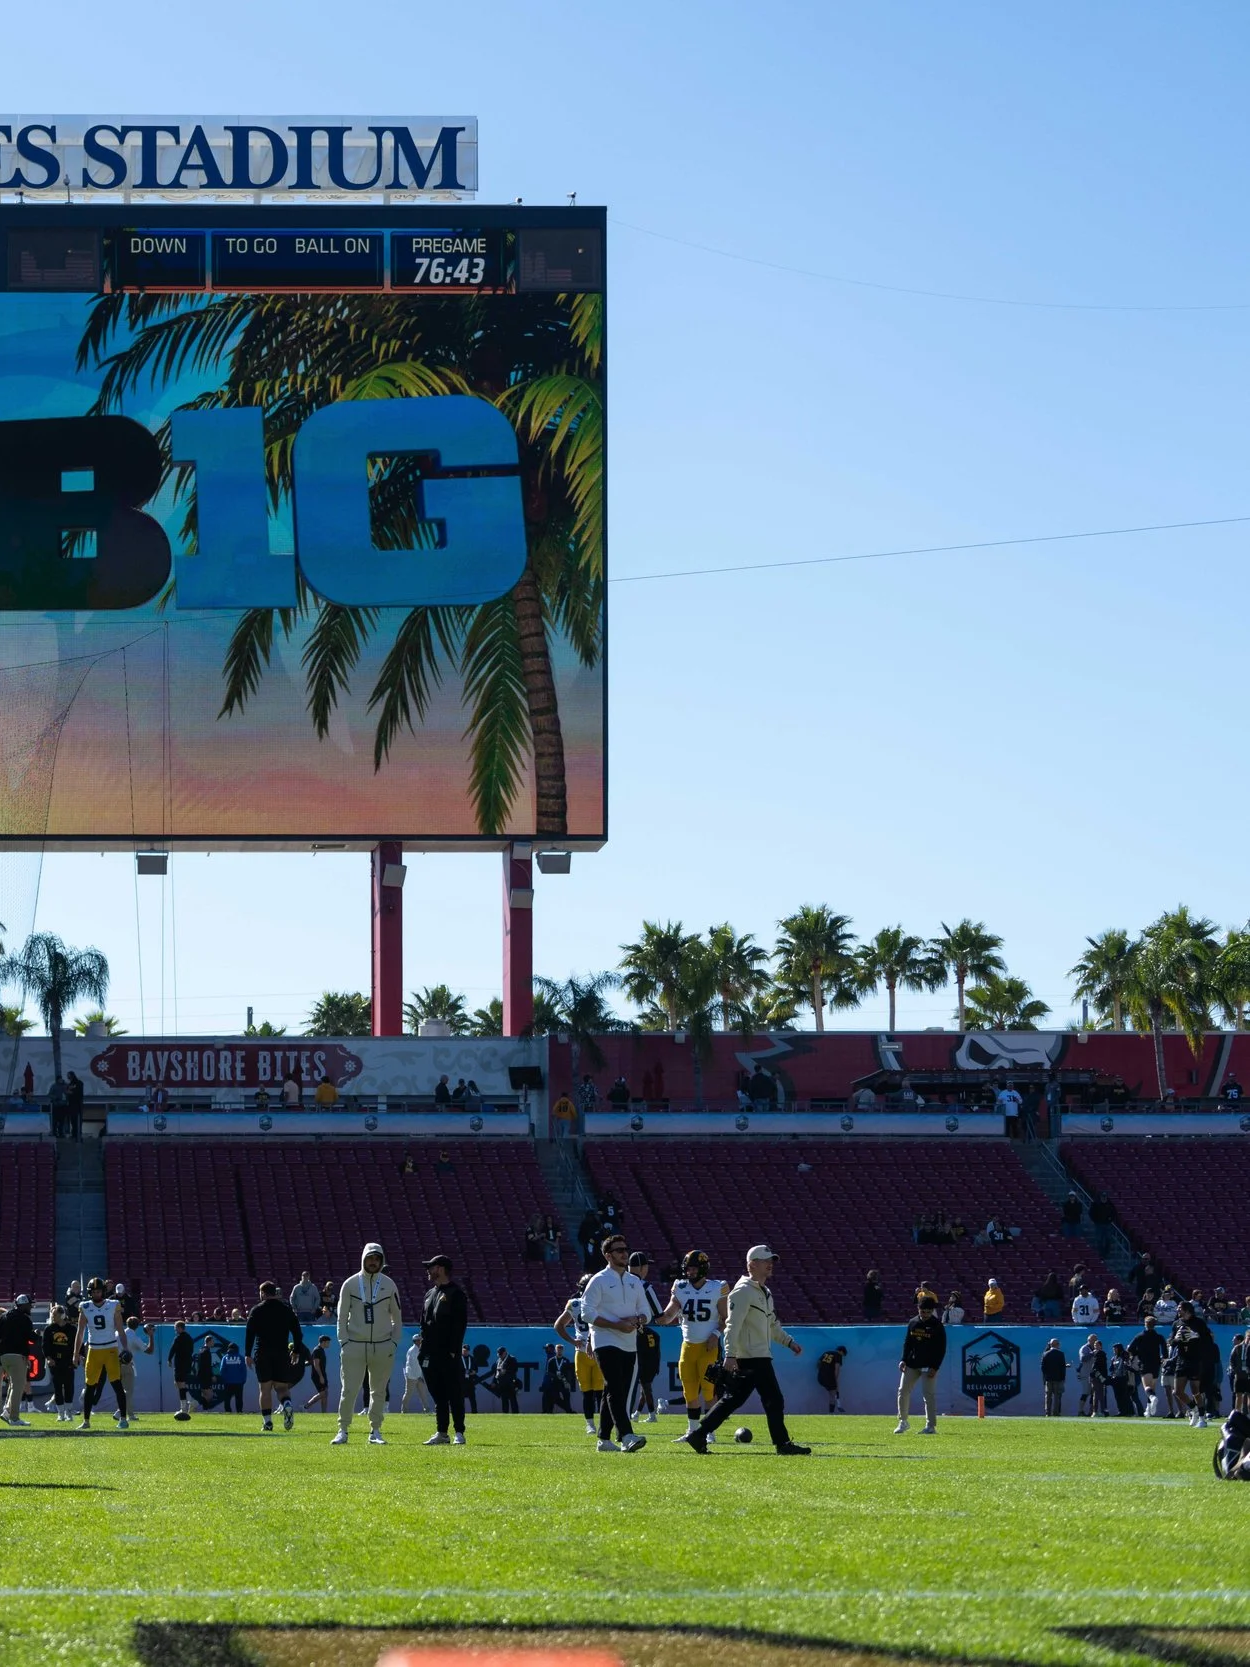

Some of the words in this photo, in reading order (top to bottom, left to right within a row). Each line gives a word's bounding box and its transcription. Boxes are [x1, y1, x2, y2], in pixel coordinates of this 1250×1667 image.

[82, 124, 466, 191] STADIUM
[130, 238, 187, 254] DOWN
[225, 238, 248, 254] TO
[253, 238, 277, 254] GO
[295, 238, 339, 254] BALL
[344, 238, 370, 254] ON
[412, 238, 486, 254] PREGAME
[413, 258, 485, 284] 76:43
[127, 1051, 246, 1081] BAYSHORE
[258, 1051, 327, 1082] BITES
[682, 1299, 711, 1322] 45
[1079, 1305, 1089, 1315] 31
[93, 1315, 106, 1330] 9
[966, 1383, 1012, 1391] RELIAQUEST
